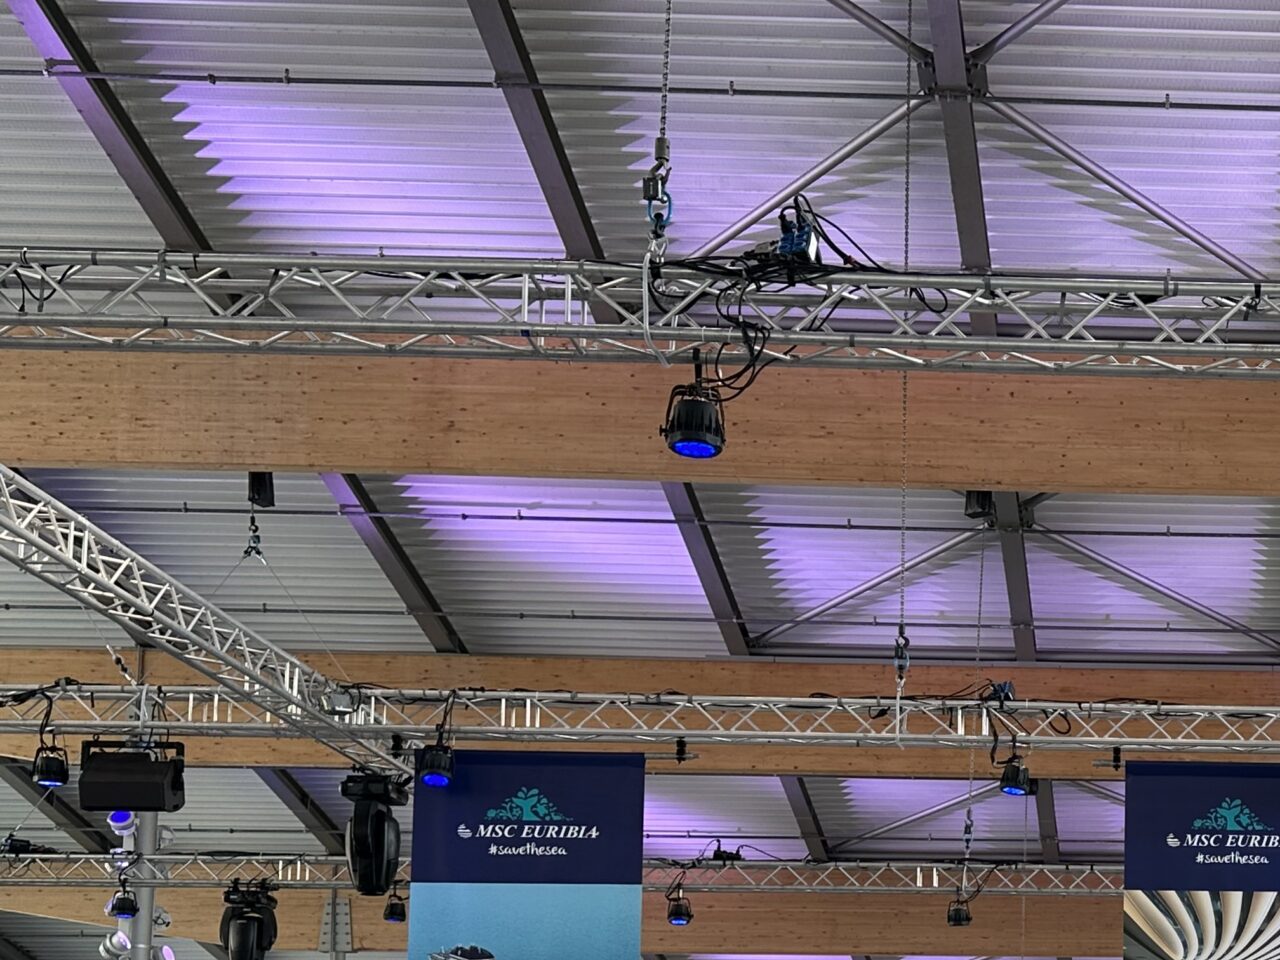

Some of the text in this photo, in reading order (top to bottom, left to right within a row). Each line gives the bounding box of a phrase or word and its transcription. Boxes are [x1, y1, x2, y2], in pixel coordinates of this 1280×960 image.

[475, 824, 600, 839] MSC EURIBIA
[1183, 834, 1222, 847] MSC
[488, 842, 568, 856] #savethesea
[1195, 851, 1270, 864] #savethesea
